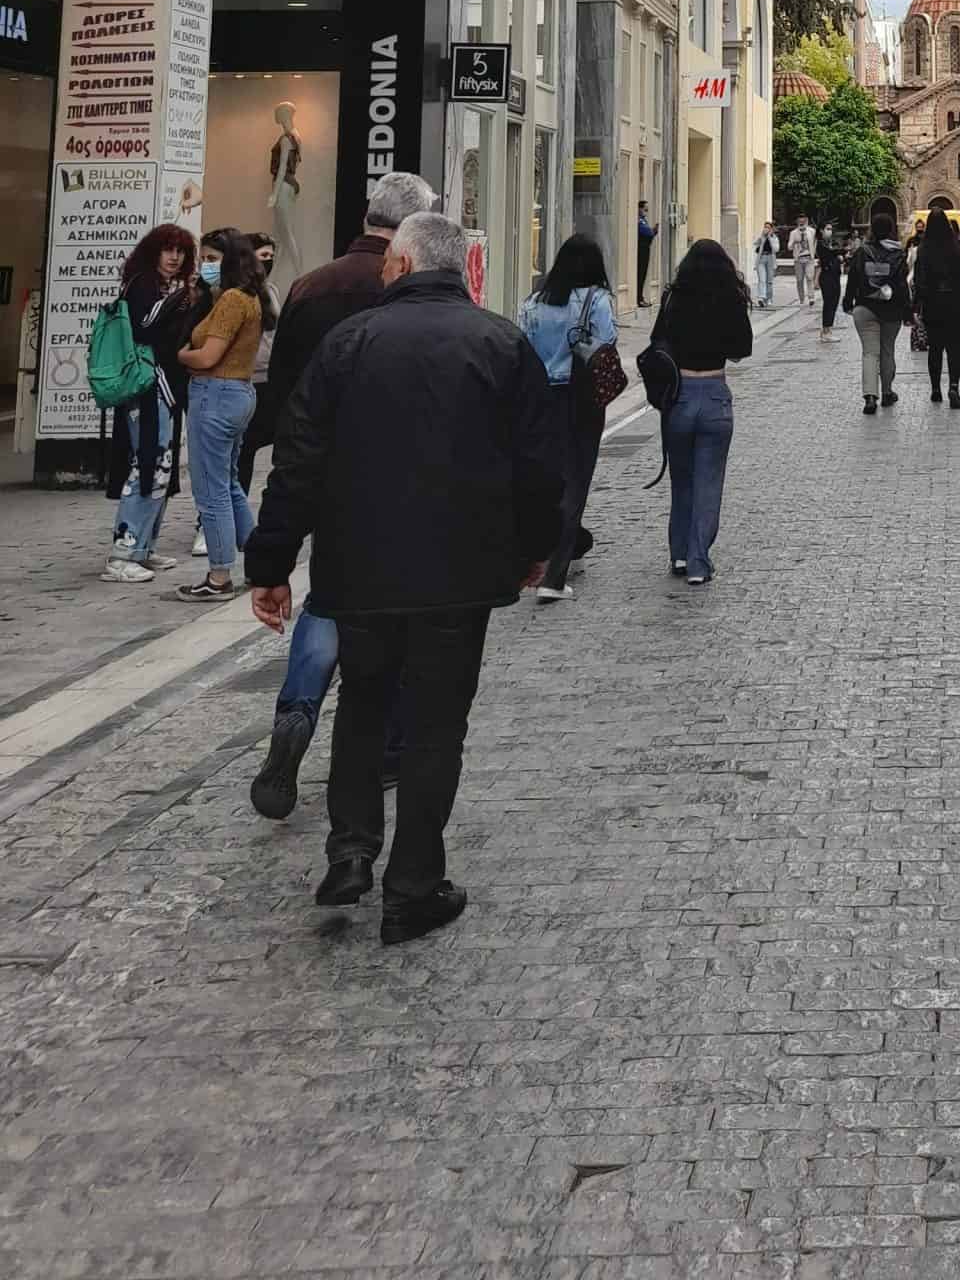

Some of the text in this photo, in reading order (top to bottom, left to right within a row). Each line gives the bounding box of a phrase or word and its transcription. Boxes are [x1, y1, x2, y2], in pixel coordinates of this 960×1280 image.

[83, 9, 146, 26] ΑΓΟΡΕΣ
[72, 21, 155, 41] ΠΩΛΗΣΕΙΣ
[71, 50, 156, 66] ΚΟΣΜΗΜΑΤΩΝ
[69, 76, 154, 91] ΡΟΛΟΓΙΩΝ
[459, 75, 498, 94] fiftysix
[67, 99, 154, 120] ΣΤΙΣ ΚΑΛΥΤΕΡΕΣ ΤΙΜΕΣ
[66, 135, 150, 158] 4ος όροφος
[88, 169, 147, 179] BILLION
[88, 180, 153, 191] MARKET
[82, 200, 126, 210] ΑΓΟΡΑ
[60, 215, 147, 226] ΧΡΥΣΑΦΙΚΩΝ
[68, 230, 138, 241] ΑΣΗΜΙΚΩΝ
[76, 250, 126, 260] ΔΑΝΕΙΑ
[59, 265, 122, 276] ΜΕ ΕΝΕΧΥ
[71, 287, 119, 297] ΠΩΛΗΣ
[51, 334, 93, 345] ΕΡΓΑΣ
